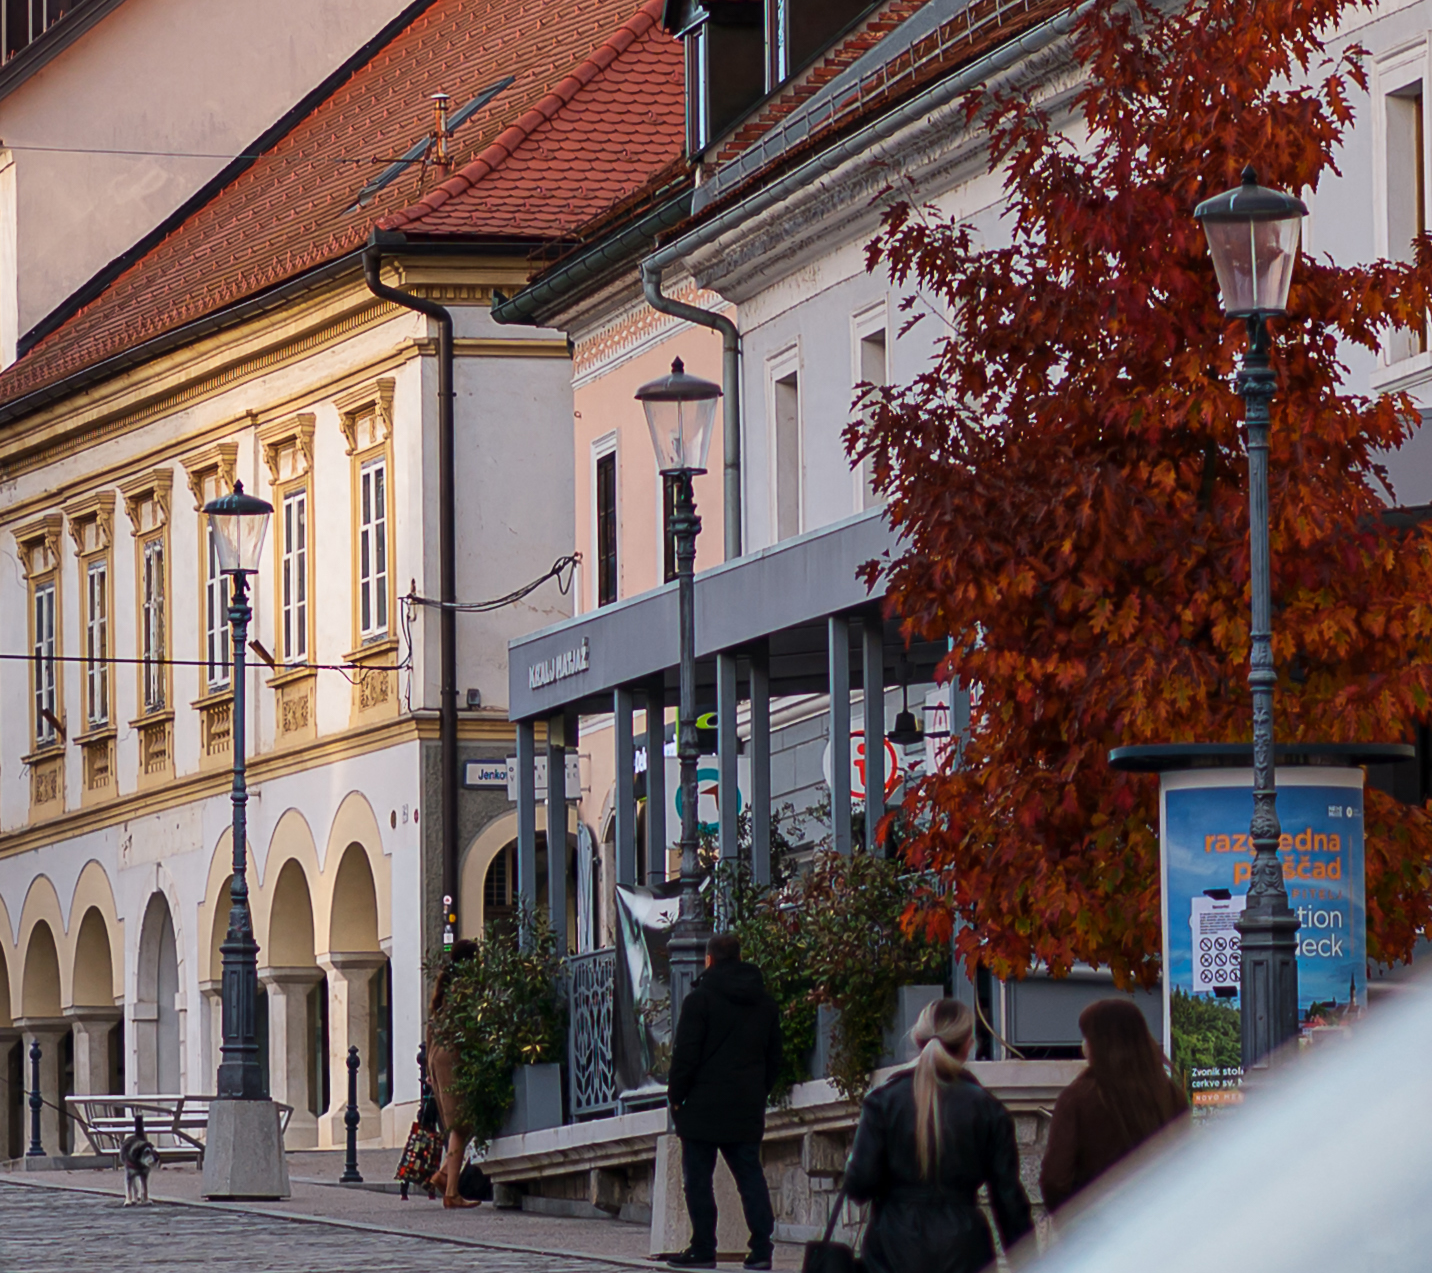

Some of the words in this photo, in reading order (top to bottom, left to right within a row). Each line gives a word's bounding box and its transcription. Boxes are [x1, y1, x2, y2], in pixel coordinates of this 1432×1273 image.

[478, 769, 507, 780] Jenko
[1204, 827, 1341, 856] razgedna
[1233, 855, 1341, 885] pščad
[1291, 888, 1343, 900] PITELJ
[1192, 1067, 1220, 1077] Zvonik
[1192, 1078, 1220, 1088] cerkve
